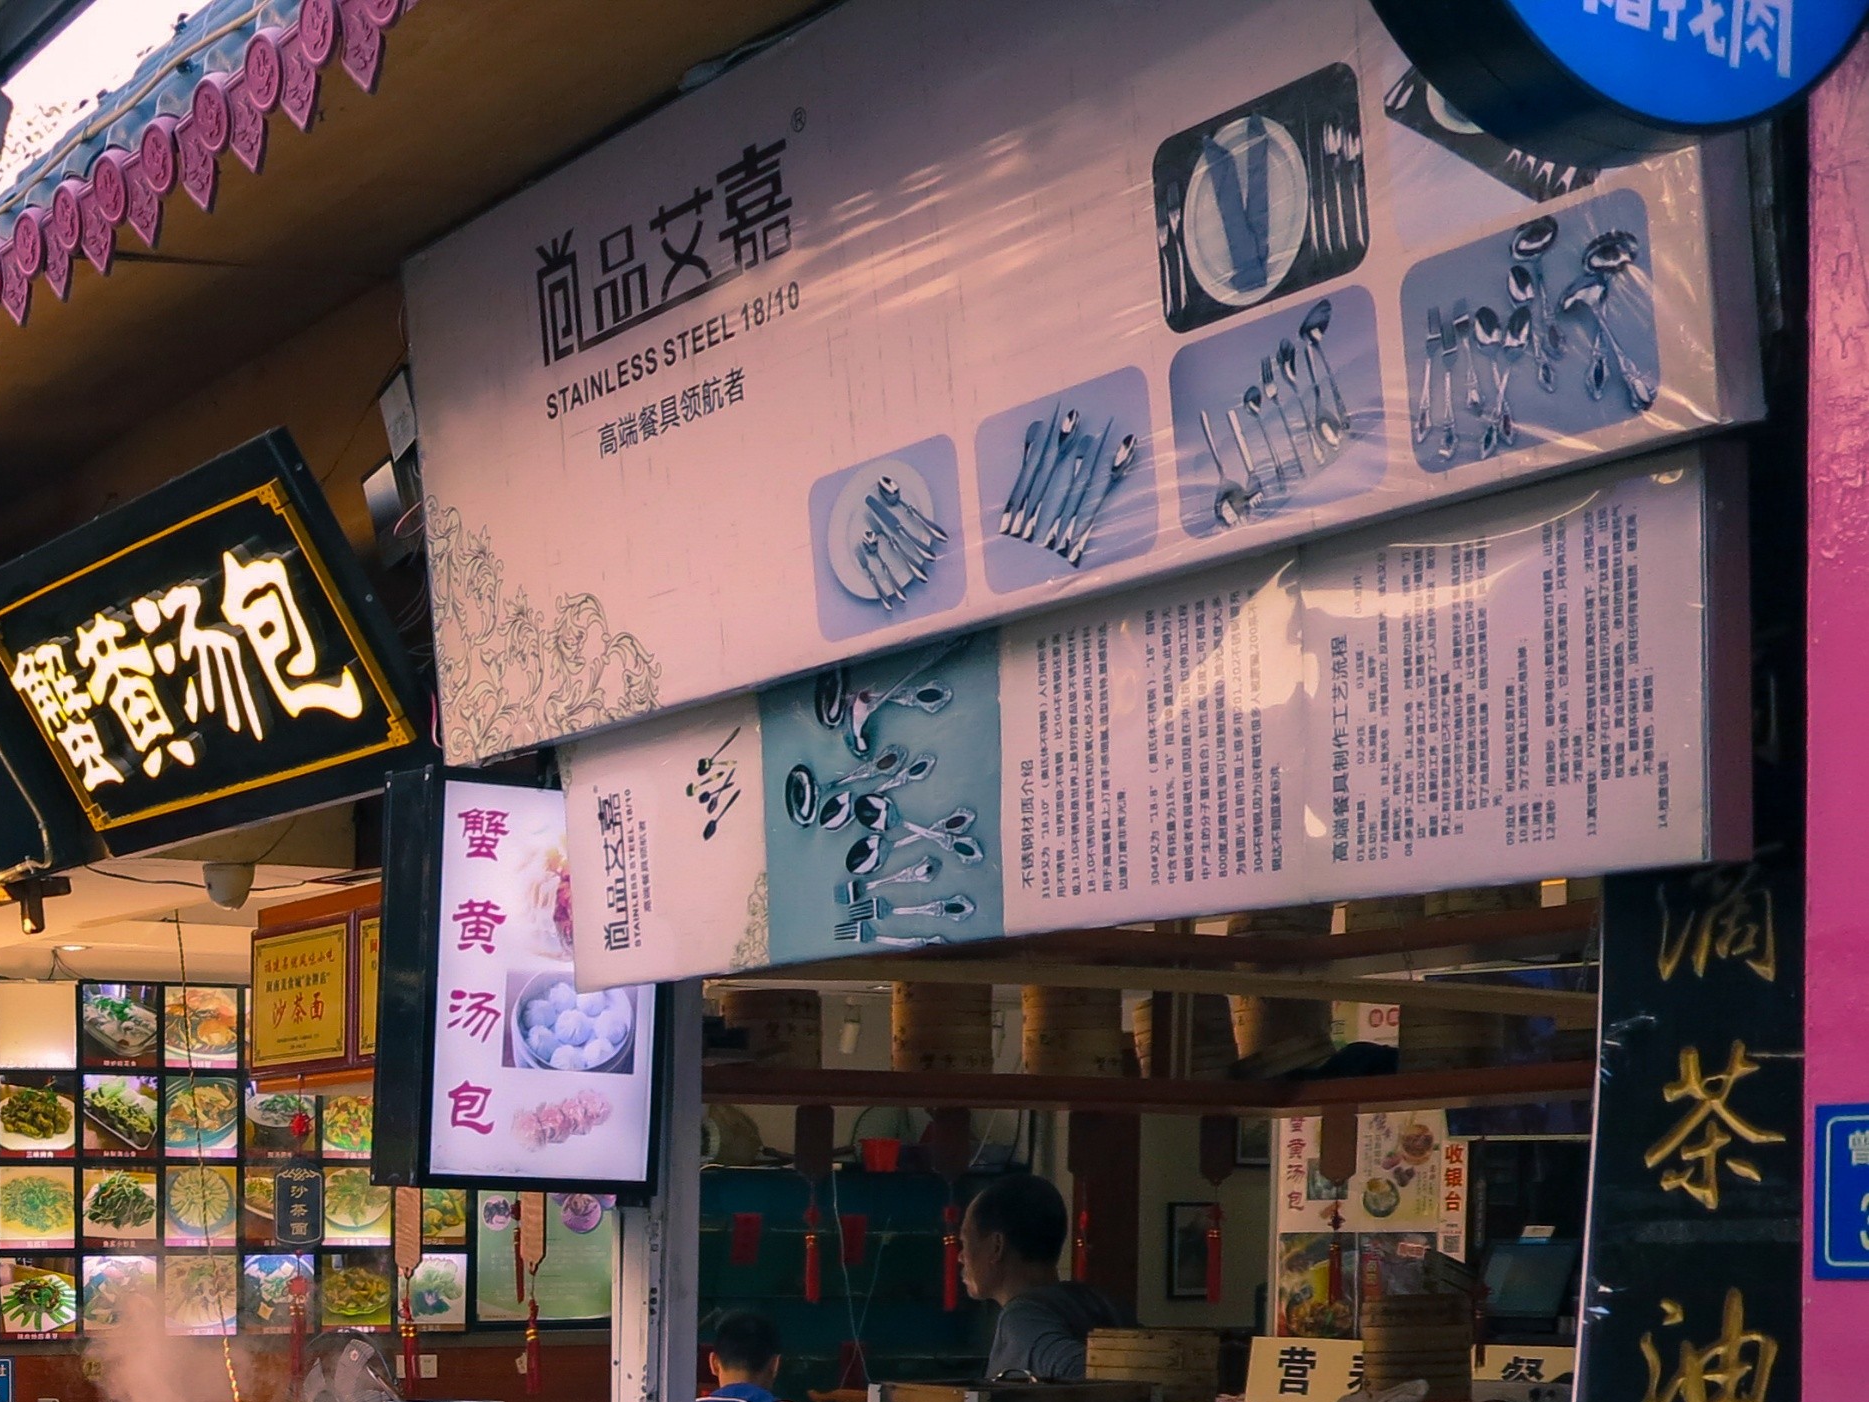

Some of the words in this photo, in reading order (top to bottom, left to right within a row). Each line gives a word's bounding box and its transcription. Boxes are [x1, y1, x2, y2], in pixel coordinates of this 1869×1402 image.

[536, 137, 793, 367] 尚品艾嘉
[546, 347, 658, 420] STAINLESS
[662, 316, 735, 368] STEEL
[739, 280, 800, 331] 18/10
[597, 367, 746, 460] 高端餐具领航者
[10, 550, 364, 792] 蟹黄汤包
[272, 991, 325, 1030] 沙茶面
[446, 808, 511, 1136] 蟹黄汤包
[1444, 1144, 1466, 1212] 收银台
